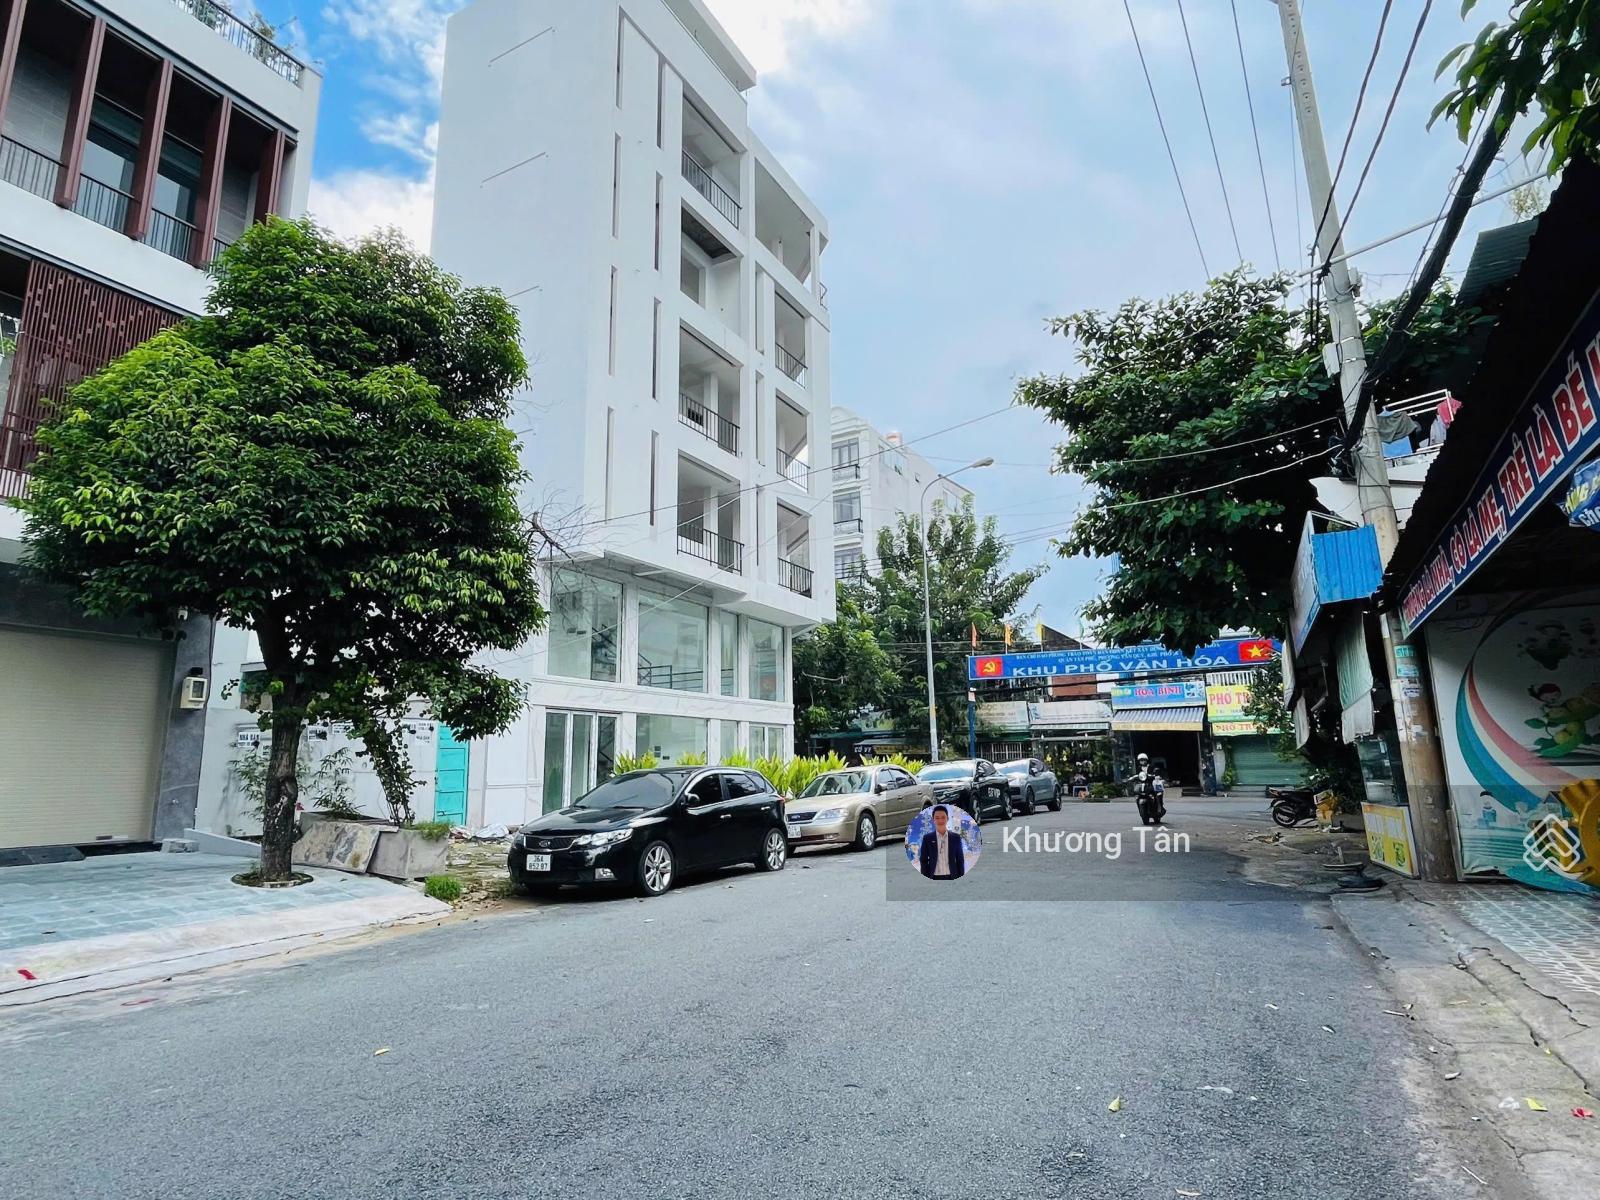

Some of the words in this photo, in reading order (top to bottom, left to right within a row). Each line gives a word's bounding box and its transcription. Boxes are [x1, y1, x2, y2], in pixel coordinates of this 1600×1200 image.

[1463, 506, 1484, 562] LÀ
[1497, 432, 1535, 517] TRẺ
[1525, 402, 1565, 482] LÀ
[1552, 350, 1597, 452] BÉ
[1013, 666, 1057, 676] KHU
[1065, 659, 1112, 674] PHỐ
[1119, 657, 1167, 671] VĂN
[1177, 654, 1230, 668] HÓA
